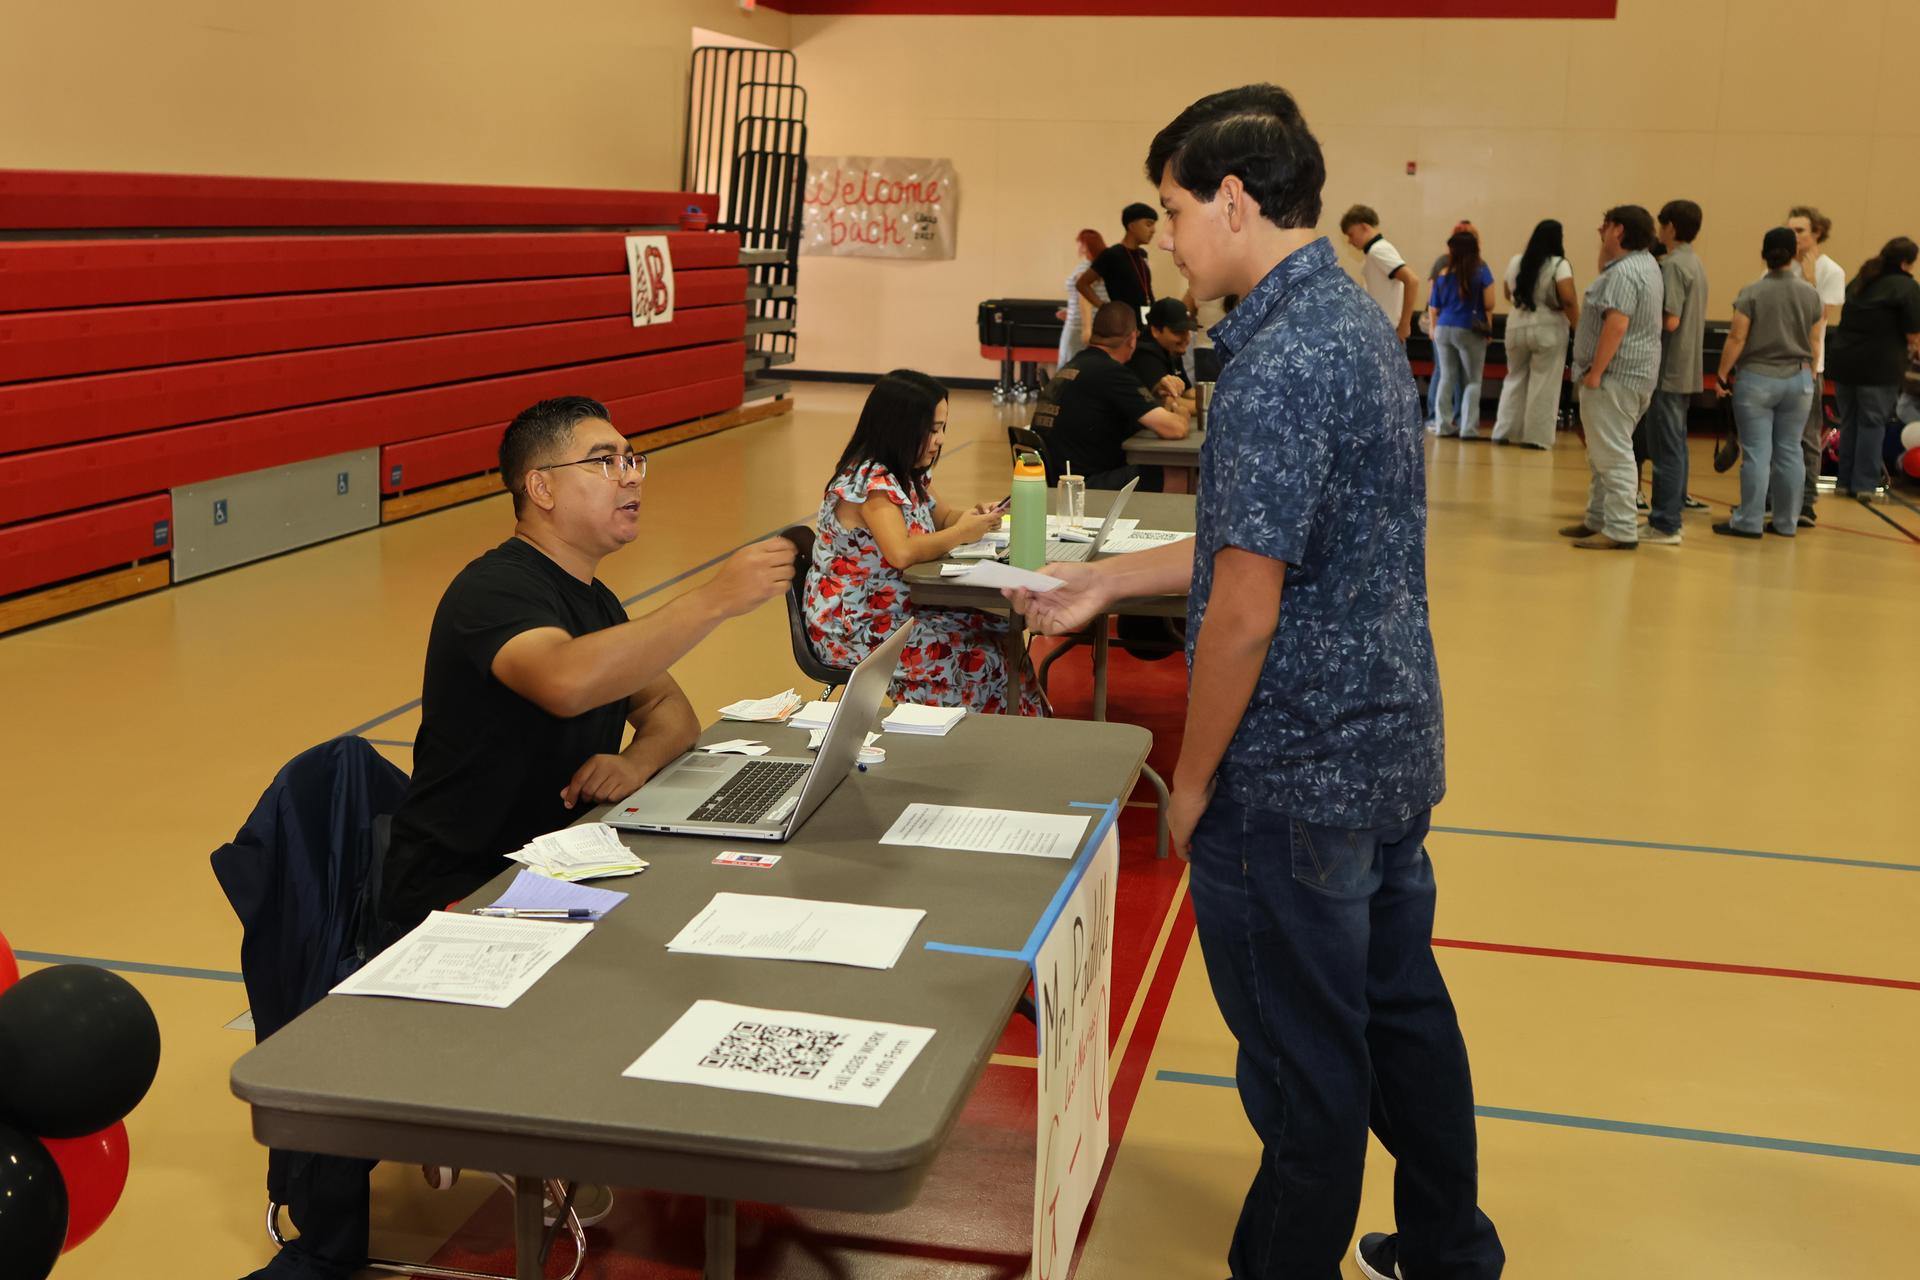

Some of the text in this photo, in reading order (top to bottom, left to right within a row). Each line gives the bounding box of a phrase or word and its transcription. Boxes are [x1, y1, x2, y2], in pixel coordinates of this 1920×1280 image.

[803, 168, 942, 206] Welcome
[824, 210, 905, 246] back
[1043, 960, 1069, 1092] Mr.
[828, 1073, 853, 1092] Fall
[860, 1031, 888, 1054] WORK
[870, 1060, 894, 1076] Info
[883, 1038, 912, 1059] Form
